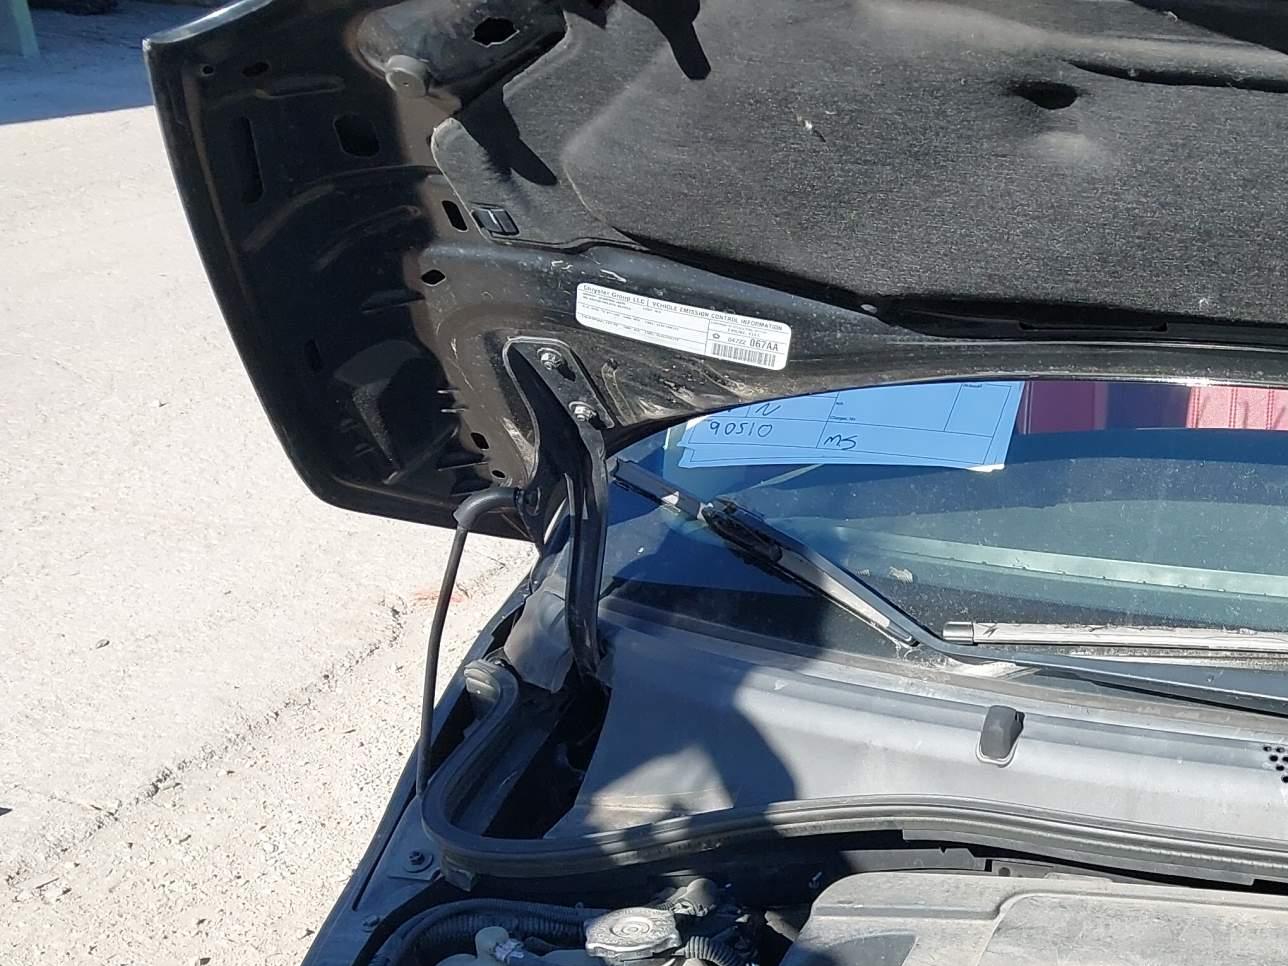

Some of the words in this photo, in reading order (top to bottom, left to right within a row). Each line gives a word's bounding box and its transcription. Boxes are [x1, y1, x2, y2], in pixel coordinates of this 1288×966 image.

[611, 292, 631, 302] Group
[652, 300, 677, 311] VEHICLE
[679, 306, 709, 317] EMISSION
[711, 313, 738, 324] CONTROL
[740, 318, 783, 331] INFORMATION
[709, 421, 773, 438] 90510
